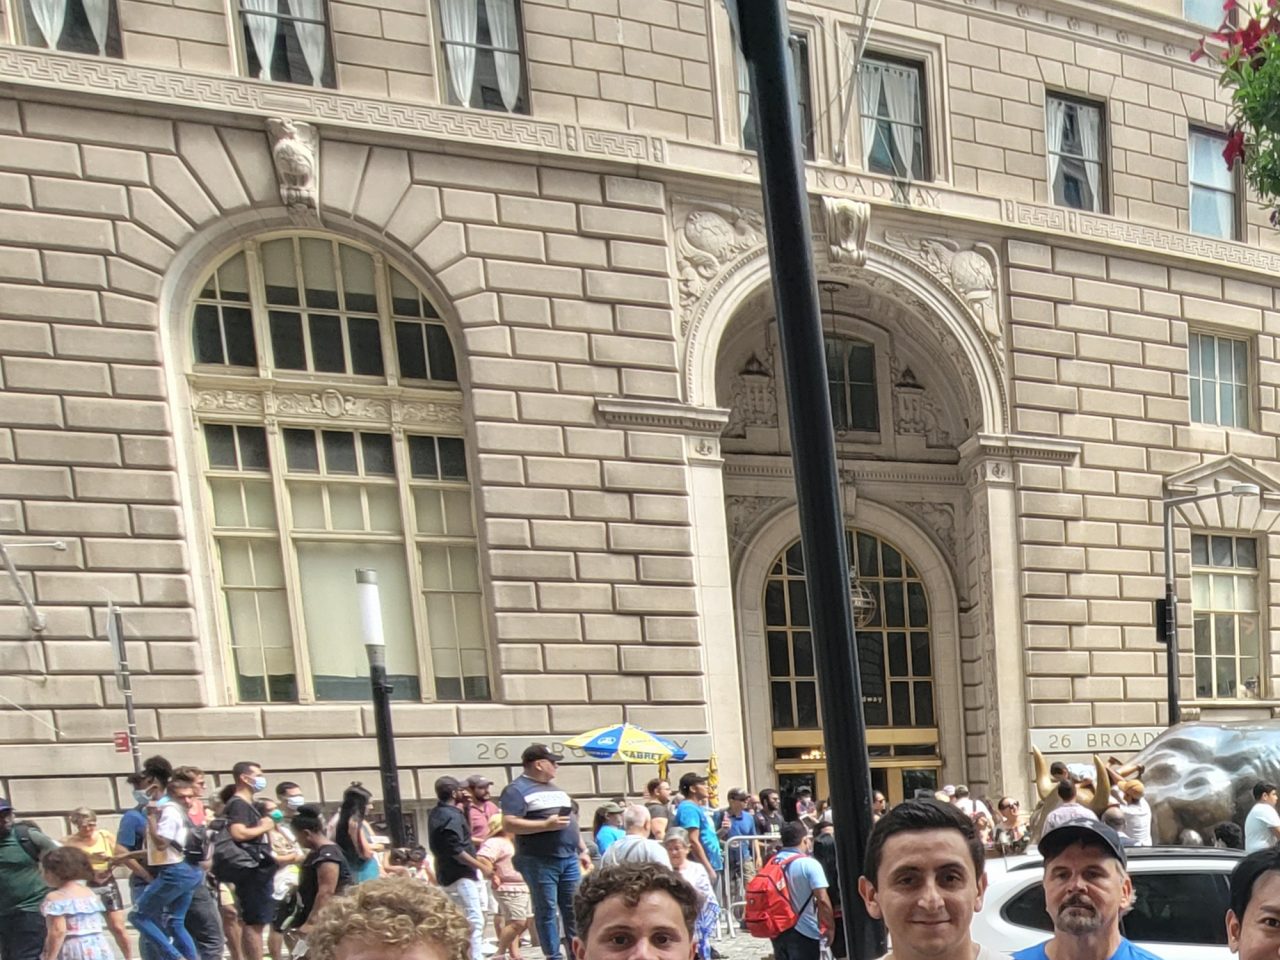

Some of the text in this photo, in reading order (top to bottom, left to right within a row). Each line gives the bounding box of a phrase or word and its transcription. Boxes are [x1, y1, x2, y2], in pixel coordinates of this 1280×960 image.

[1049, 732, 1159, 749] 26 BROAD
[476, 742, 509, 760] 26
